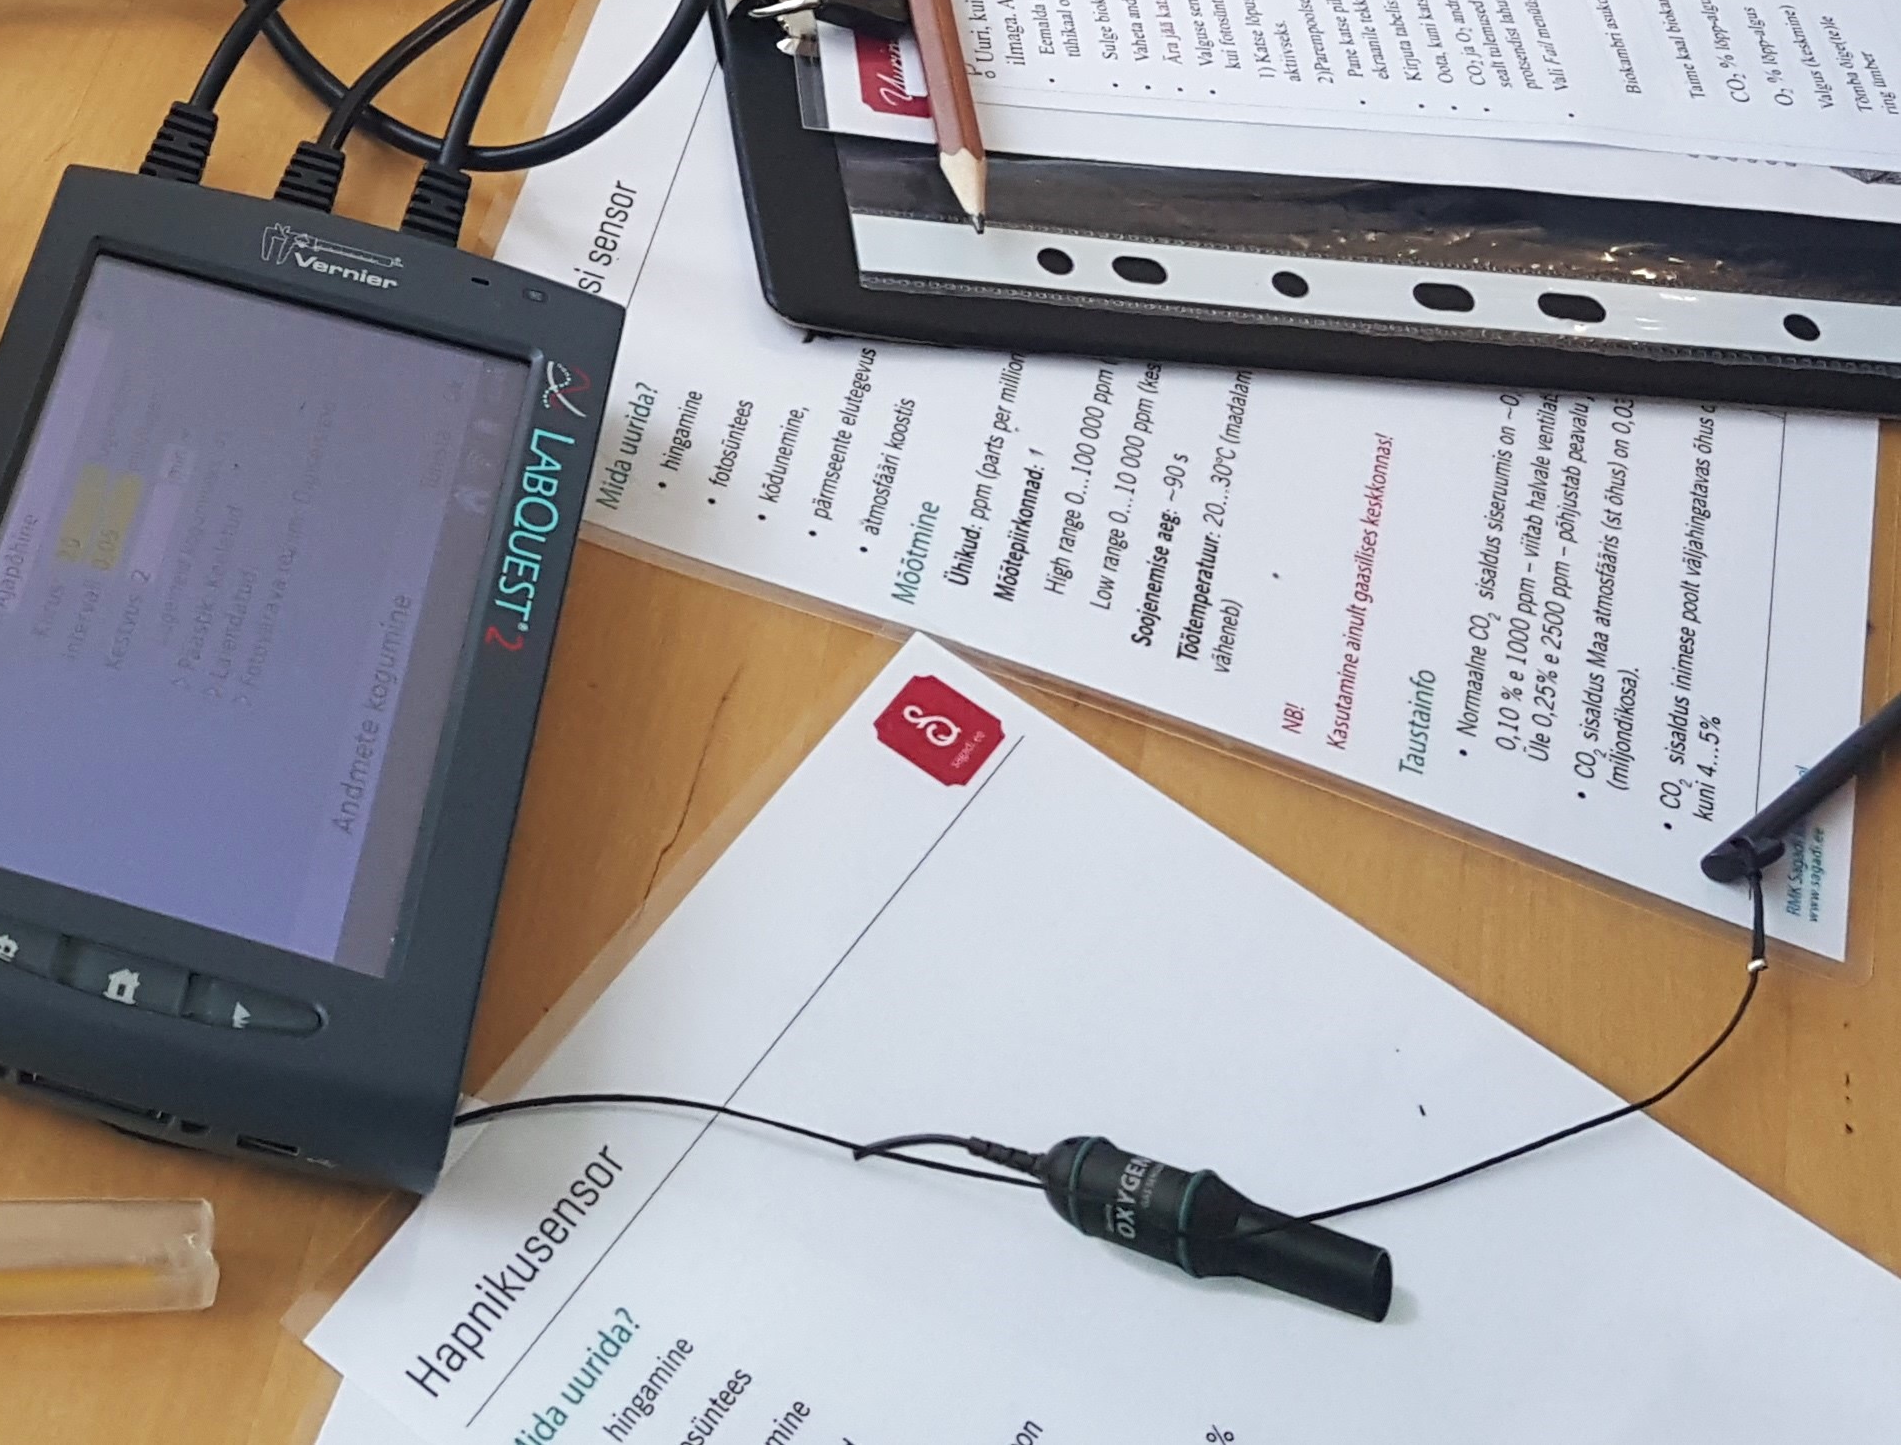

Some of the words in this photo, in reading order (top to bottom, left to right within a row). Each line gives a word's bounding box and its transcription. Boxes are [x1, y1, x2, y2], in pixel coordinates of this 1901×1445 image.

[967, 0, 989, 23] kui
[1777, 3, 1822, 69] (keskmine)
[972, 25, 996, 63] Uuri,
[1002, 12, 1027, 67] ilmaga.
[1097, 24, 1120, 62] Sulge
[1397, 39, 1424, 82] Kirjuta
[1608, 31, 1644, 95] Biokambri
[1666, 34, 1694, 62] kaal
[1715, 53, 1738, 70] %
[1818, 14, 1856, 70] õige(te)le
[1682, 62, 1707, 100] Taime
[1809, 69, 1836, 111] Valgus
[1844, 70, 1875, 114] Tõmba
[586, 178, 639, 268] sensor
[294, 251, 399, 289] Vernier
[1091, 367, 1116, 407] ppm
[658, 389, 705, 473] hingamine
[812, 428, 854, 523] pärmseente
[837, 346, 878, 428] elutegevus
[991, 403, 1014, 435] per
[1078, 404, 1106, 441] 000
[1131, 396, 1156, 436] ppm
[1497, 424, 1518, 447] on
[1691, 415, 1716, 456] õhus
[594, 458, 634, 512] Mida
[618, 380, 660, 457] uurida?
[706, 398, 755, 489] fotosüntees
[756, 405, 812, 505] kõdunemine,
[857, 450, 902, 538] atmosfääri
[882, 396, 917, 452] koostis
[973, 433, 1006, 481] (parts
[1118, 433, 1147, 470] 000
[1171, 451, 1191, 465] s
[1612, 437, 1632, 460] on
[1062, 440, 1098, 507] 0...100
[1106, 470, 1139, 526] 0...10
[1161, 463, 1188, 504] ~90
[1357, 430, 1395, 529] keskkonnas!
[1486, 447, 1515, 534] siseruumis
[1523, 454, 1552, 513] halvale
[1602, 460, 1630, 508] õhus)
[968, 482, 995, 523] ppm
[1155, 507, 1183, 544] aeg:
[1553, 464, 1583, 546] põhjustab
[1598, 506, 1624, 532] (st
[1680, 456, 1713, 578] väljahingatavas
[889, 499, 942, 607] Mõõtmine
[941, 522, 985, 588] Ühikud:
[991, 463, 1047, 604] Mõõtepiirkonnad:
[1056, 507, 1086, 555] range
[1101, 526, 1130, 574] range
[1520, 513, 1545, 559] viitab
[1560, 544, 1568, 558] –
[1042, 555, 1075, 597] High
[1352, 526, 1380, 605] gaasilises
[1476, 533, 1503, 602] sisaldus
[1525, 560, 1534, 575] –
[1550, 559, 1575, 602] ppm
[1591, 532, 1621, 629] atmosfääris
[1087, 573, 1117, 612] Low
[1129, 543, 1172, 649] Soojenemise
[1174, 530, 1223, 663] Töötemperatuur:
[1515, 575, 1540, 618] ppm
[1677, 578, 1703, 626] poolt
[485, 626, 524, 651] 2
[1211, 597, 1245, 675] väheneb)
[1344, 602, 1369, 653] ainult
[1503, 615, 1532, 667] 1000
[1538, 599, 1567, 652] 2500
[1584, 629, 1611, 670] Maa
[1507, 669, 1526, 684] e
[1542, 652, 1562, 666] e
[1668, 624, 1698, 693] inimese
[331, 719, 380, 836] Andmete
[363, 594, 412, 712] kogumine
[1324, 652, 1361, 752] Kasutamine
[1454, 643, 1489, 739] Normaalne
[1498, 684, 1525, 704] %
[1529, 667, 1560, 730] 0,25%
[1579, 670, 1607, 744] sisaldus
[1279, 700, 1307, 736] NB!
[1396, 668, 1438, 777] Taustainfo
[1493, 705, 1523, 752] 0,10
[1604, 666, 1642, 792] (miljondikosa).
[1665, 693, 1692, 767] sisaldus
[1526, 731, 1553, 764] Üle
[1694, 713, 1723, 780] 4...5%
[1690, 778, 1717, 824] kuni
[404, 1144, 624, 1399] Hapnikusensor
[560, 1306, 641, 1406] uurida?
[601, 1338, 694, 1442] hingamine
[682, 1368, 753, 1445] süntees
